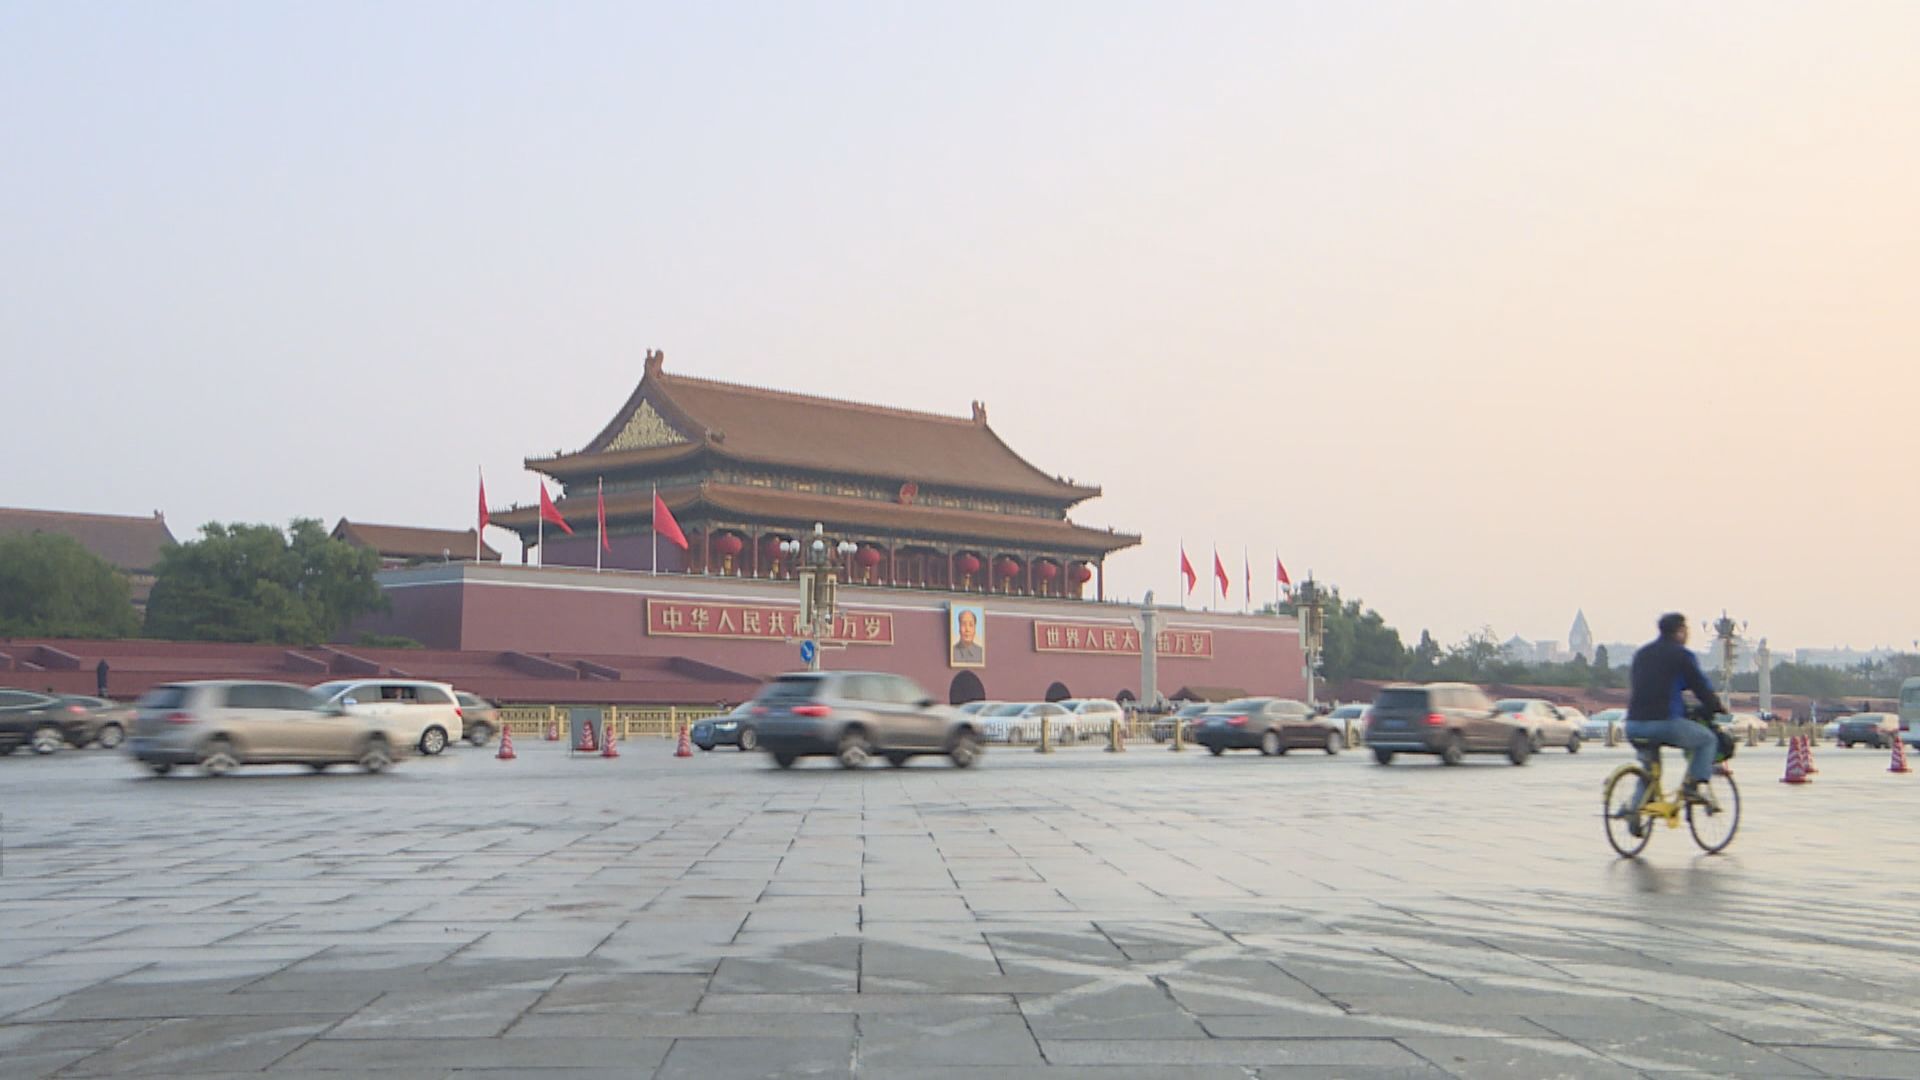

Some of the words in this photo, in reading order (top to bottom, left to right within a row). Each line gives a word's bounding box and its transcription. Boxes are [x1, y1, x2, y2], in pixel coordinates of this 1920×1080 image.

[1046, 626, 1204, 653] 世界人民大结万岁
